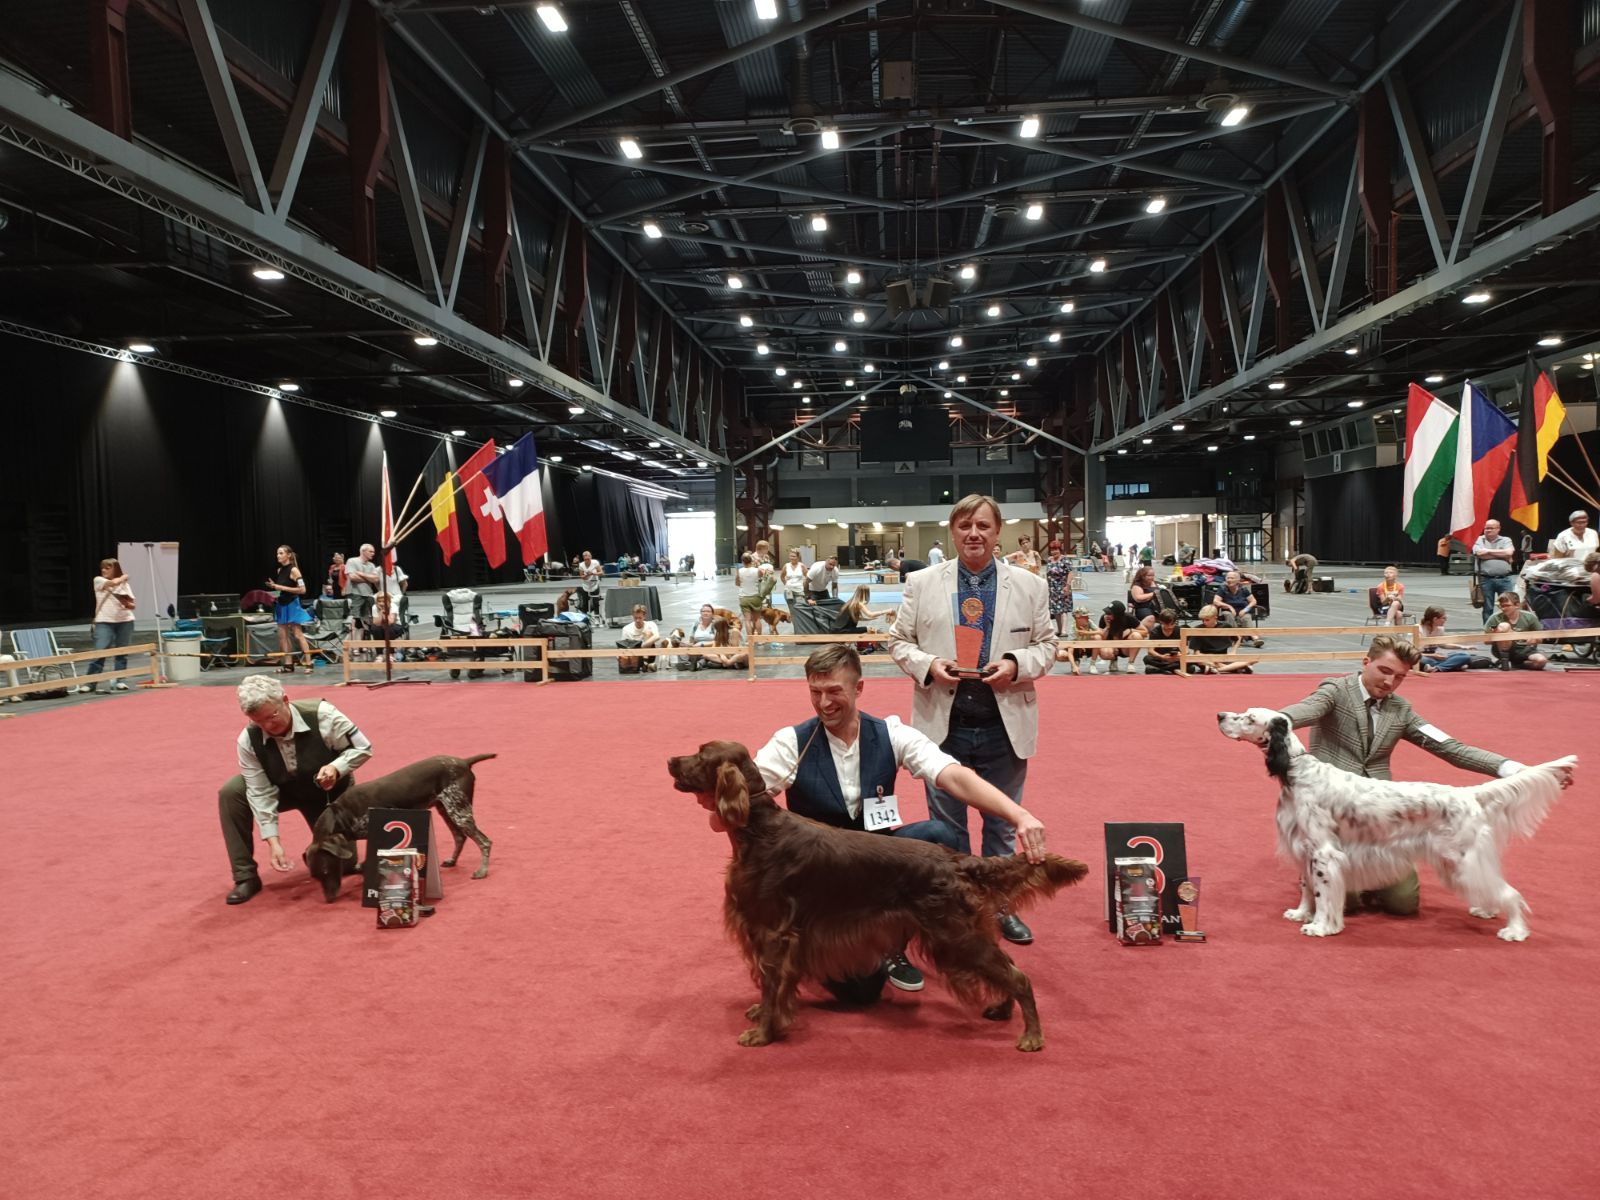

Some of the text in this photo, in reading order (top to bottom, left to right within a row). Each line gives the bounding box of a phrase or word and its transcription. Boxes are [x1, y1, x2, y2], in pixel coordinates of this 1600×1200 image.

[869, 809, 897, 825] 1342
[383, 820, 413, 849] 2
[1161, 915, 1181, 924] AN
